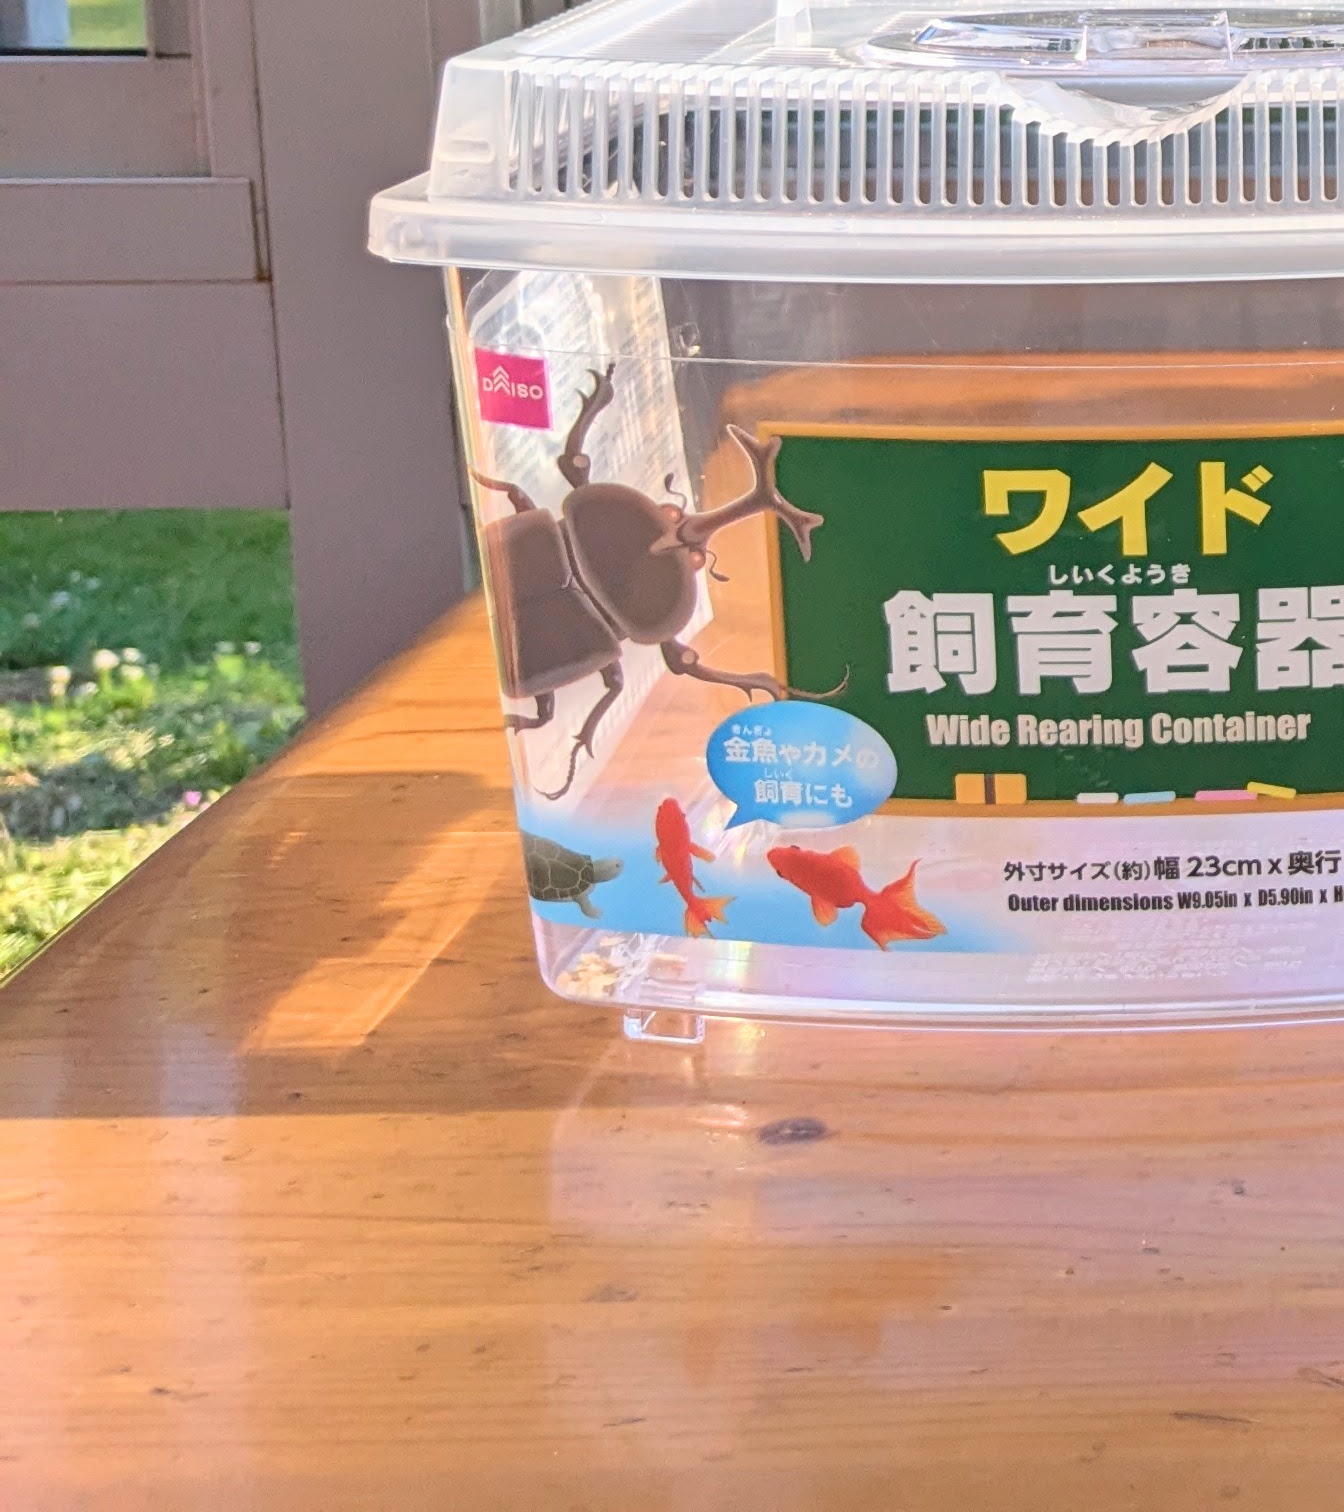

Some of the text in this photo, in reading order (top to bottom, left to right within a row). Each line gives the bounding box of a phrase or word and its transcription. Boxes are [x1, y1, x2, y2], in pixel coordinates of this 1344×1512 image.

[482, 365, 544, 401] DAISO
[982, 460, 1274, 557] ワイド
[1049, 562, 1192, 586] しいくようき
[926, 709, 1312, 750] Wide Rearing Container
[723, 736, 880, 769] 金魚やカメの
[754, 778, 853, 809] 飼育にも
[1008, 893, 1058, 913] Outer
[1063, 891, 1174, 913] dimensions
[1178, 889, 1238, 910] W9.05in
[1243, 892, 1253, 908] x
[1258, 886, 1313, 907] D5.90in
[1319, 889, 1328, 905] x
